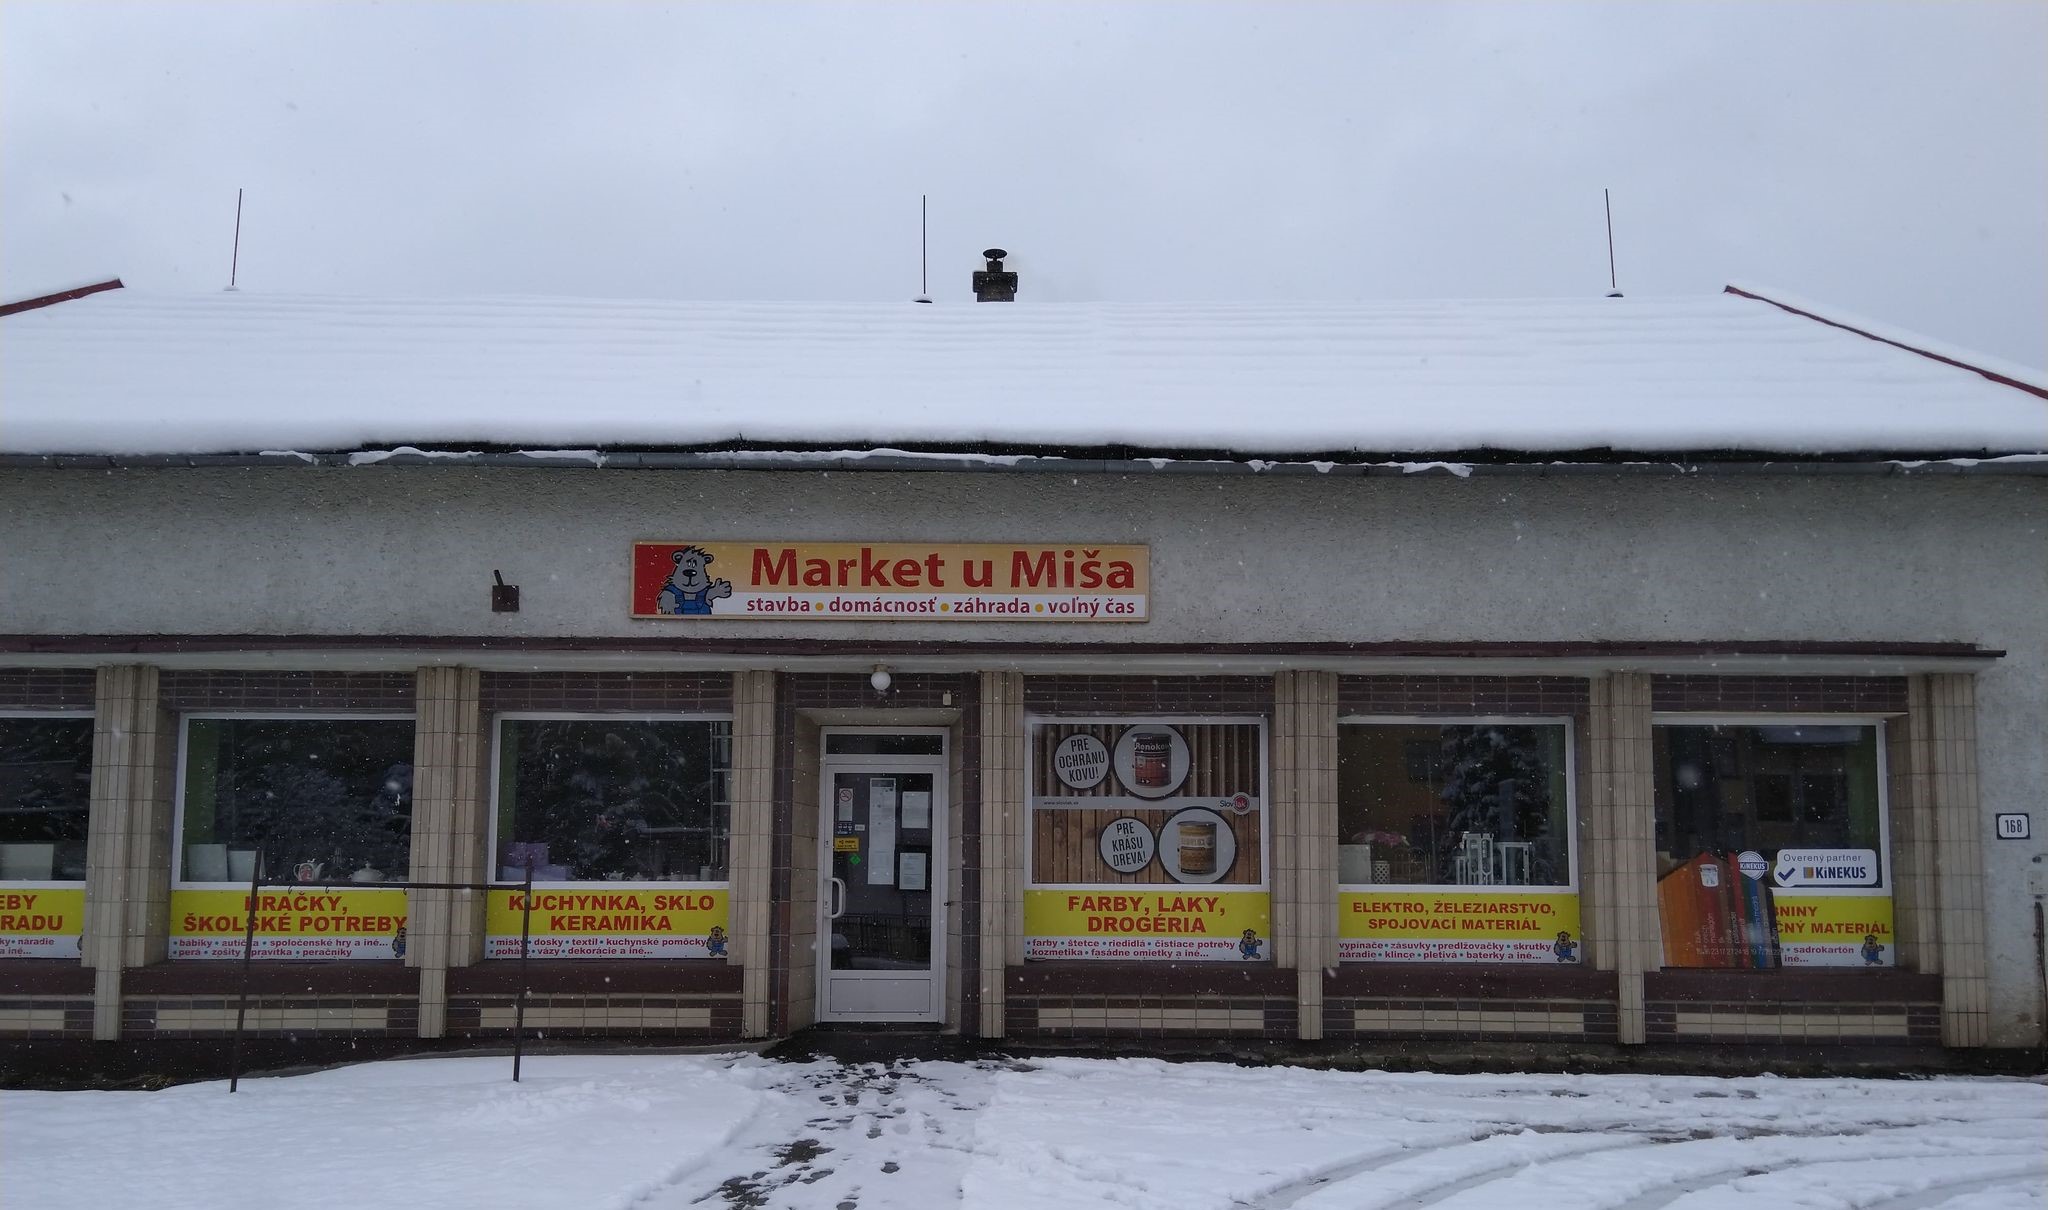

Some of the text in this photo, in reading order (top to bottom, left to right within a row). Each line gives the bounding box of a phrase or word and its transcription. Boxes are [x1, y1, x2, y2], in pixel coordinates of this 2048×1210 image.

[751, 547, 1134, 589] Market u Miša
[746, 596, 1134, 618] stavba domácnosť záhrada voľný čas
[1070, 737, 1089, 752] PRE
[1058, 750, 1106, 769] OCHRANU
[1068, 766, 1100, 783] KOVU!
[1116, 821, 1134, 836] PRE
[2005, 819, 2022, 833] 168
[1112, 834, 1143, 853] KRÁSU
[1112, 853, 1147, 867] DREVA!
[1783, 853, 1861, 864] Overený partner
[245, 891, 348, 915] HRAČKY,
[508, 895, 715, 914] KUCHYNKA, SKLO
[1068, 896, 1226, 916] FARBY, LAKY,
[1353, 900, 1556, 916] ELEKTRO, ŽELEZIARSTVO,
[183, 912, 407, 932] ŠKOLSKÉ POTREBY
[550, 915, 673, 931] KERAMIKA
[1087, 913, 1207, 933] DROGÉRIA
[1368, 916, 1541, 931] SPOJOVACÍ MATERIÁL
[1810, 920, 1890, 934] MATERIÁL
[335, 938, 352, 948] hry
[533, 938, 564, 947] dosky
[572, 938, 598, 946] textil
[606, 938, 659, 948] kuchynské
[1032, 939, 1235, 950] farby štetce riedidlá čistiace potreby
[1390, 942, 1431, 951] zásuvky
[1513, 942, 1551, 952] skrutky
[537, 947, 560, 956] vázy
[567, 947, 617, 955] dekorácie
[1031, 948, 1083, 956] kozmetika
[1091, 948, 1131, 956] fasádne
[1133, 949, 1173, 959] omietky
[1423, 951, 1457, 960] pletivá
[1466, 951, 1505, 961] baterky
